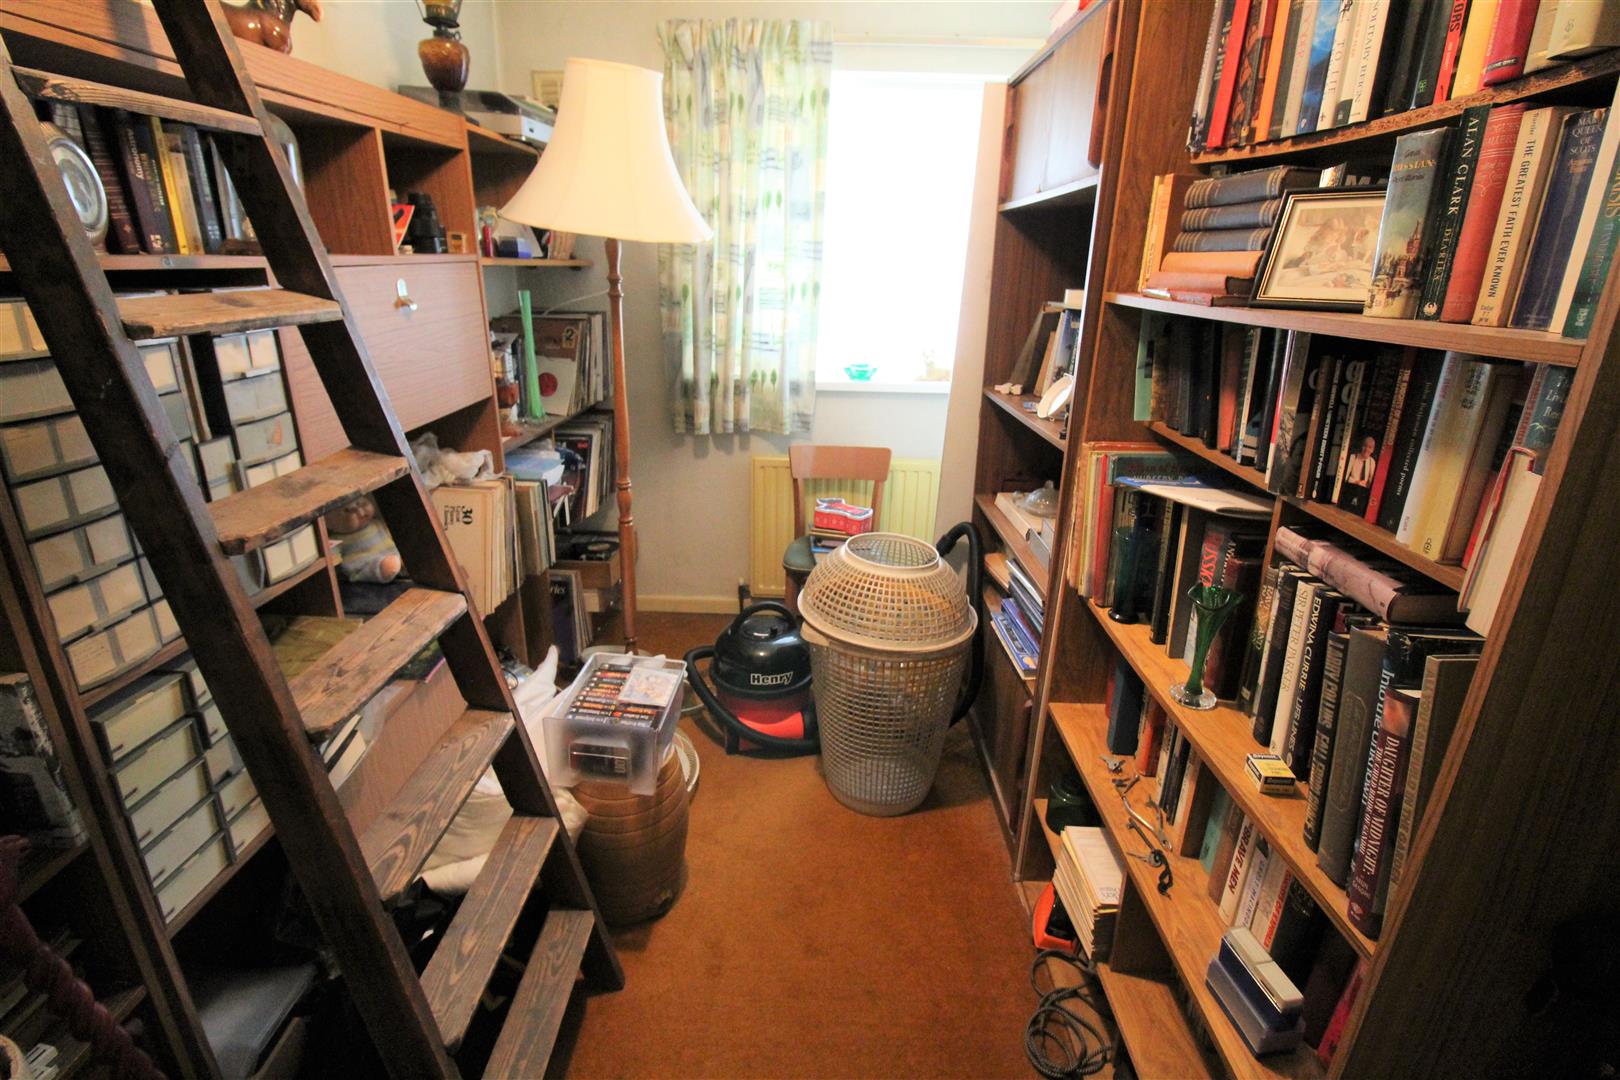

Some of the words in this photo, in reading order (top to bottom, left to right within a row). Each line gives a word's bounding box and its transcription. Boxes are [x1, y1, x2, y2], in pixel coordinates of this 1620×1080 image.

[1450, 0, 1465, 32] ORS
[125, 128, 145, 180] Astronomy
[1461, 116, 1480, 158] ALAN
[1522, 139, 1536, 157] THE
[1447, 164, 1469, 216] CLARK
[1510, 160, 1532, 208] GREATEST
[1502, 210, 1518, 238] FAITH
[1433, 227, 1453, 282] DIARIES
[1496, 239, 1510, 263] EVER
[1488, 264, 1502, 298] KNOWN
[1396, 472, 1407, 496] poems
[462, 505, 474, 525] 30
[1289, 608, 1304, 645] PETER
[1306, 596, 1322, 645] EDWINA
[750, 671, 794, 686] Henry
[1280, 646, 1297, 692] PARKER
[1298, 646, 1313, 691] CURRIE
[1324, 639, 1344, 681] LARRY
[1293, 697, 1304, 720] LIFE
[1318, 680, 1338, 728] COLLINS
[1288, 720, 1298, 751] LINES
[1313, 731, 1330, 761] FALL
[1369, 762, 1381, 788] CHILD
[1376, 736, 1400, 798] DAUGHTER
[1374, 798, 1388, 816] OF
[1237, 823, 1253, 869] BRAVE
[1363, 816, 1385, 875] MIDNIGHT:
[1391, 830, 1408, 884] GARDEN
[1228, 864, 1240, 895] MEN
